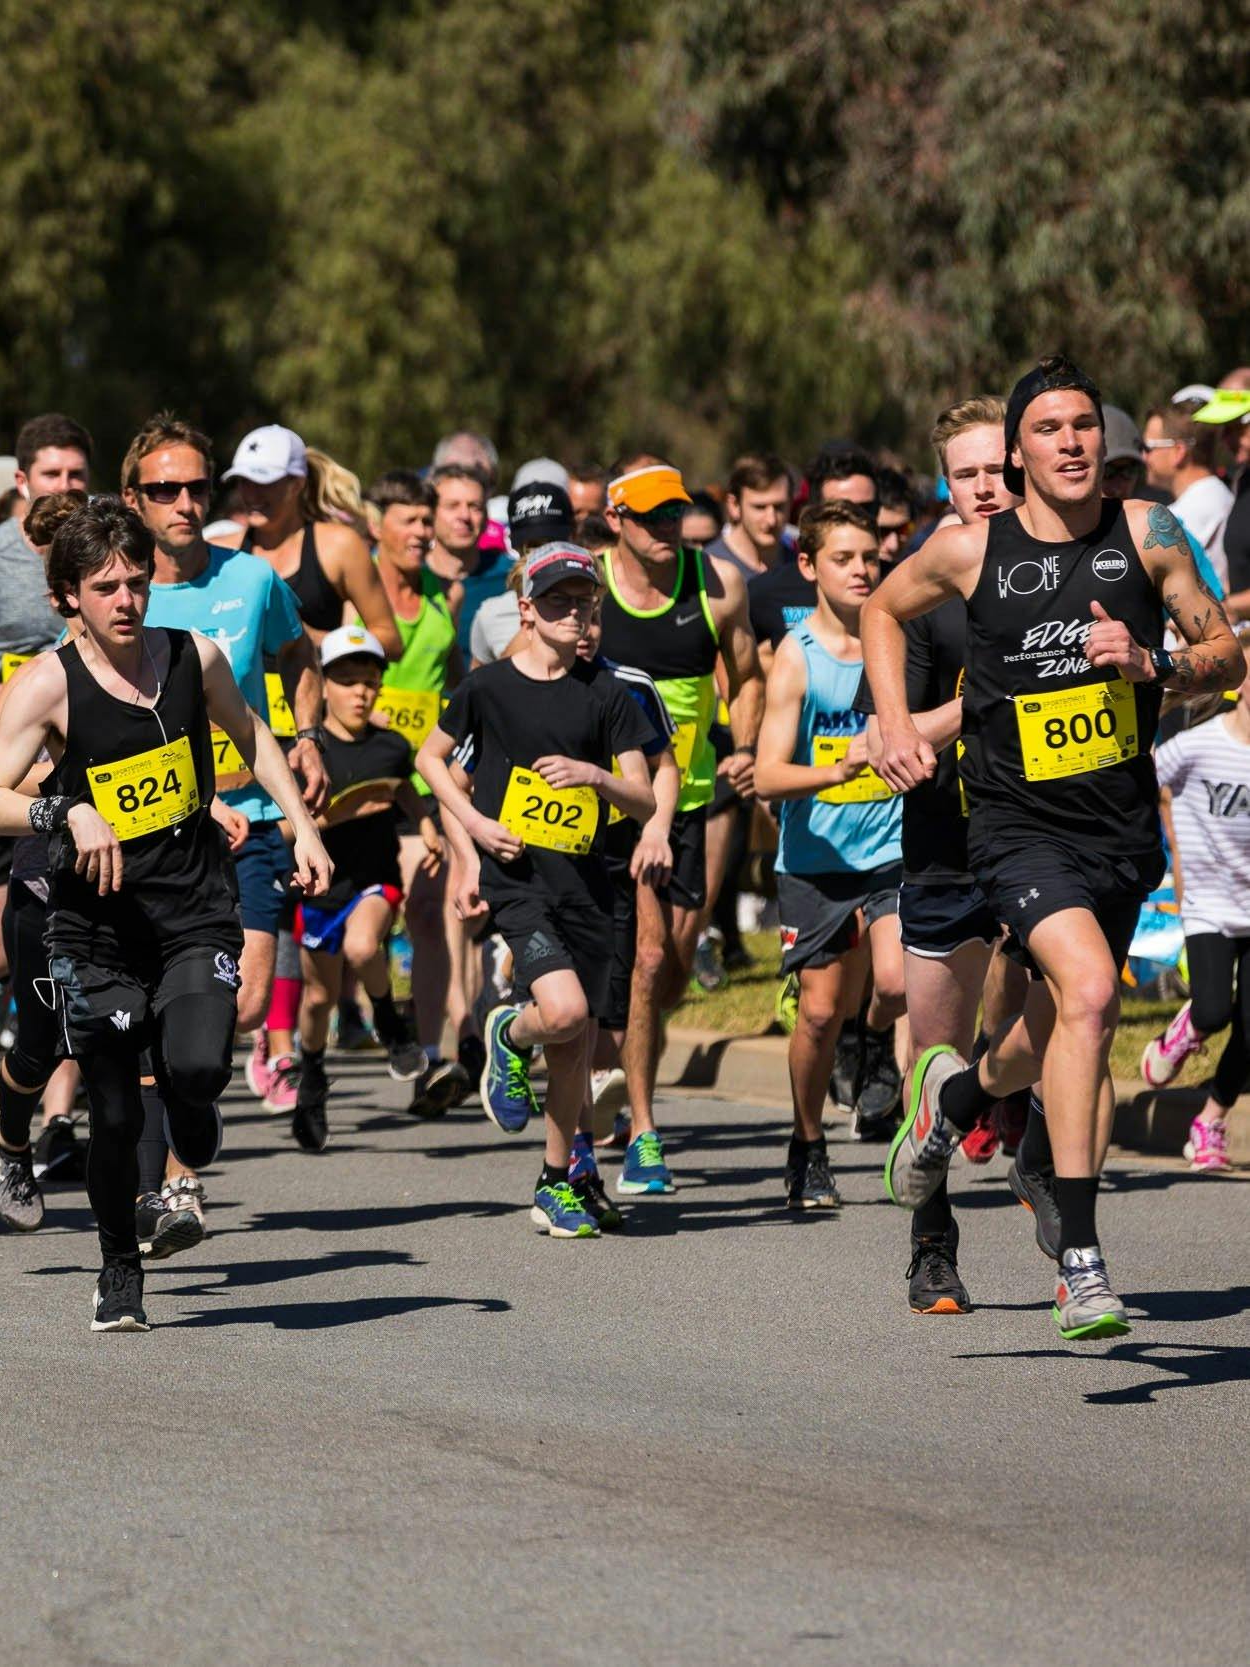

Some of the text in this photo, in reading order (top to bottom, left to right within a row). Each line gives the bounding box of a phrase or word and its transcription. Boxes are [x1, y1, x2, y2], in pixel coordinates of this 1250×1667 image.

[1003, 648, 1067, 663] Performance
[1036, 657, 1092, 679] ZONE
[1044, 708, 1117, 749] 800
[116, 768, 182, 813] 824
[521, 795, 583, 829] 202
